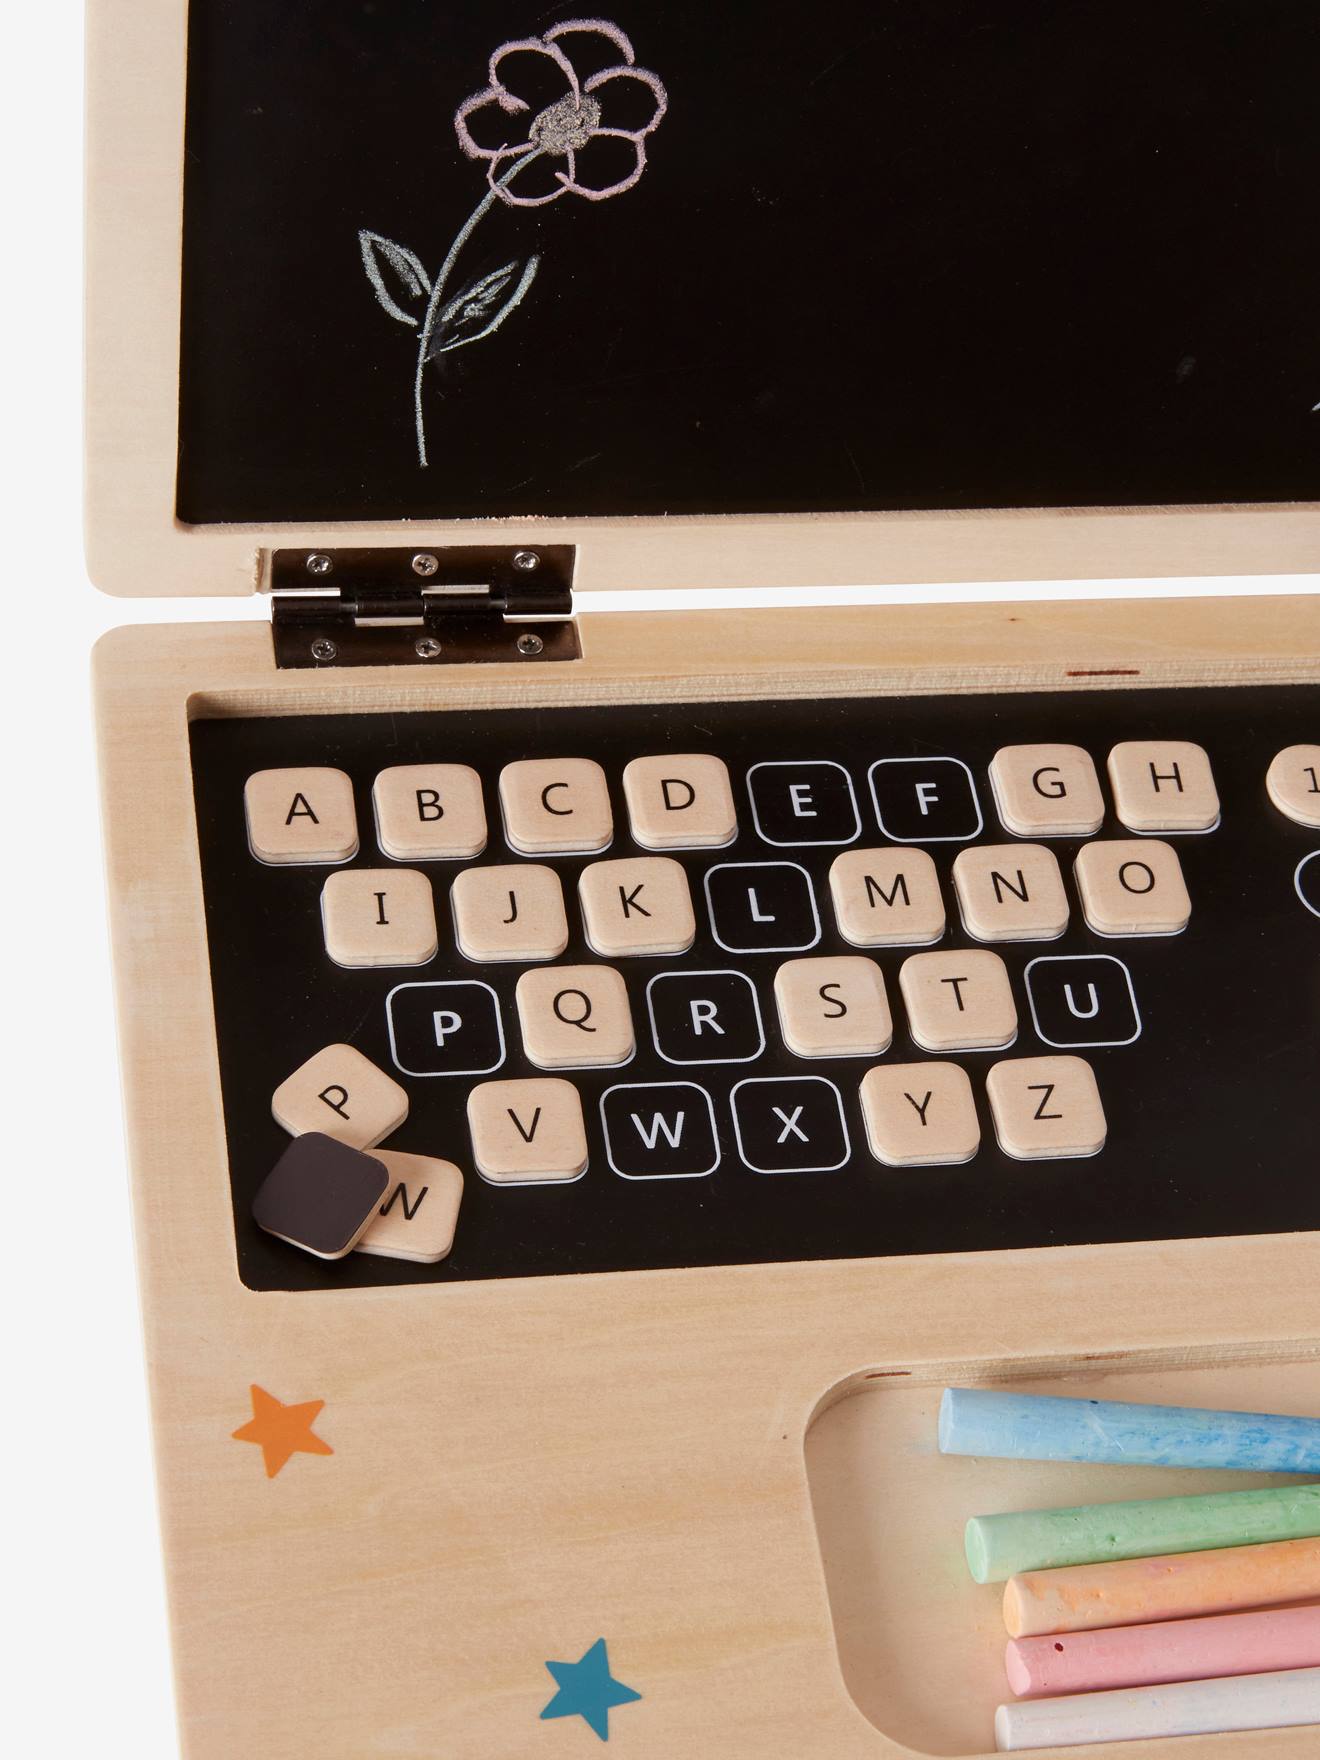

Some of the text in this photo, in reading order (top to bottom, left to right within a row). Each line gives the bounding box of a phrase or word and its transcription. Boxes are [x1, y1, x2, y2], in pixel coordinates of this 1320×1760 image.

[284, 761, 1184, 826] A B C D E F G H
[373, 861, 1156, 926] I J K L M N O
[432, 976, 1099, 1047] P Q R S T U
[317, 1084, 351, 1121] P
[506, 1083, 1063, 1149] V W X Y Z
